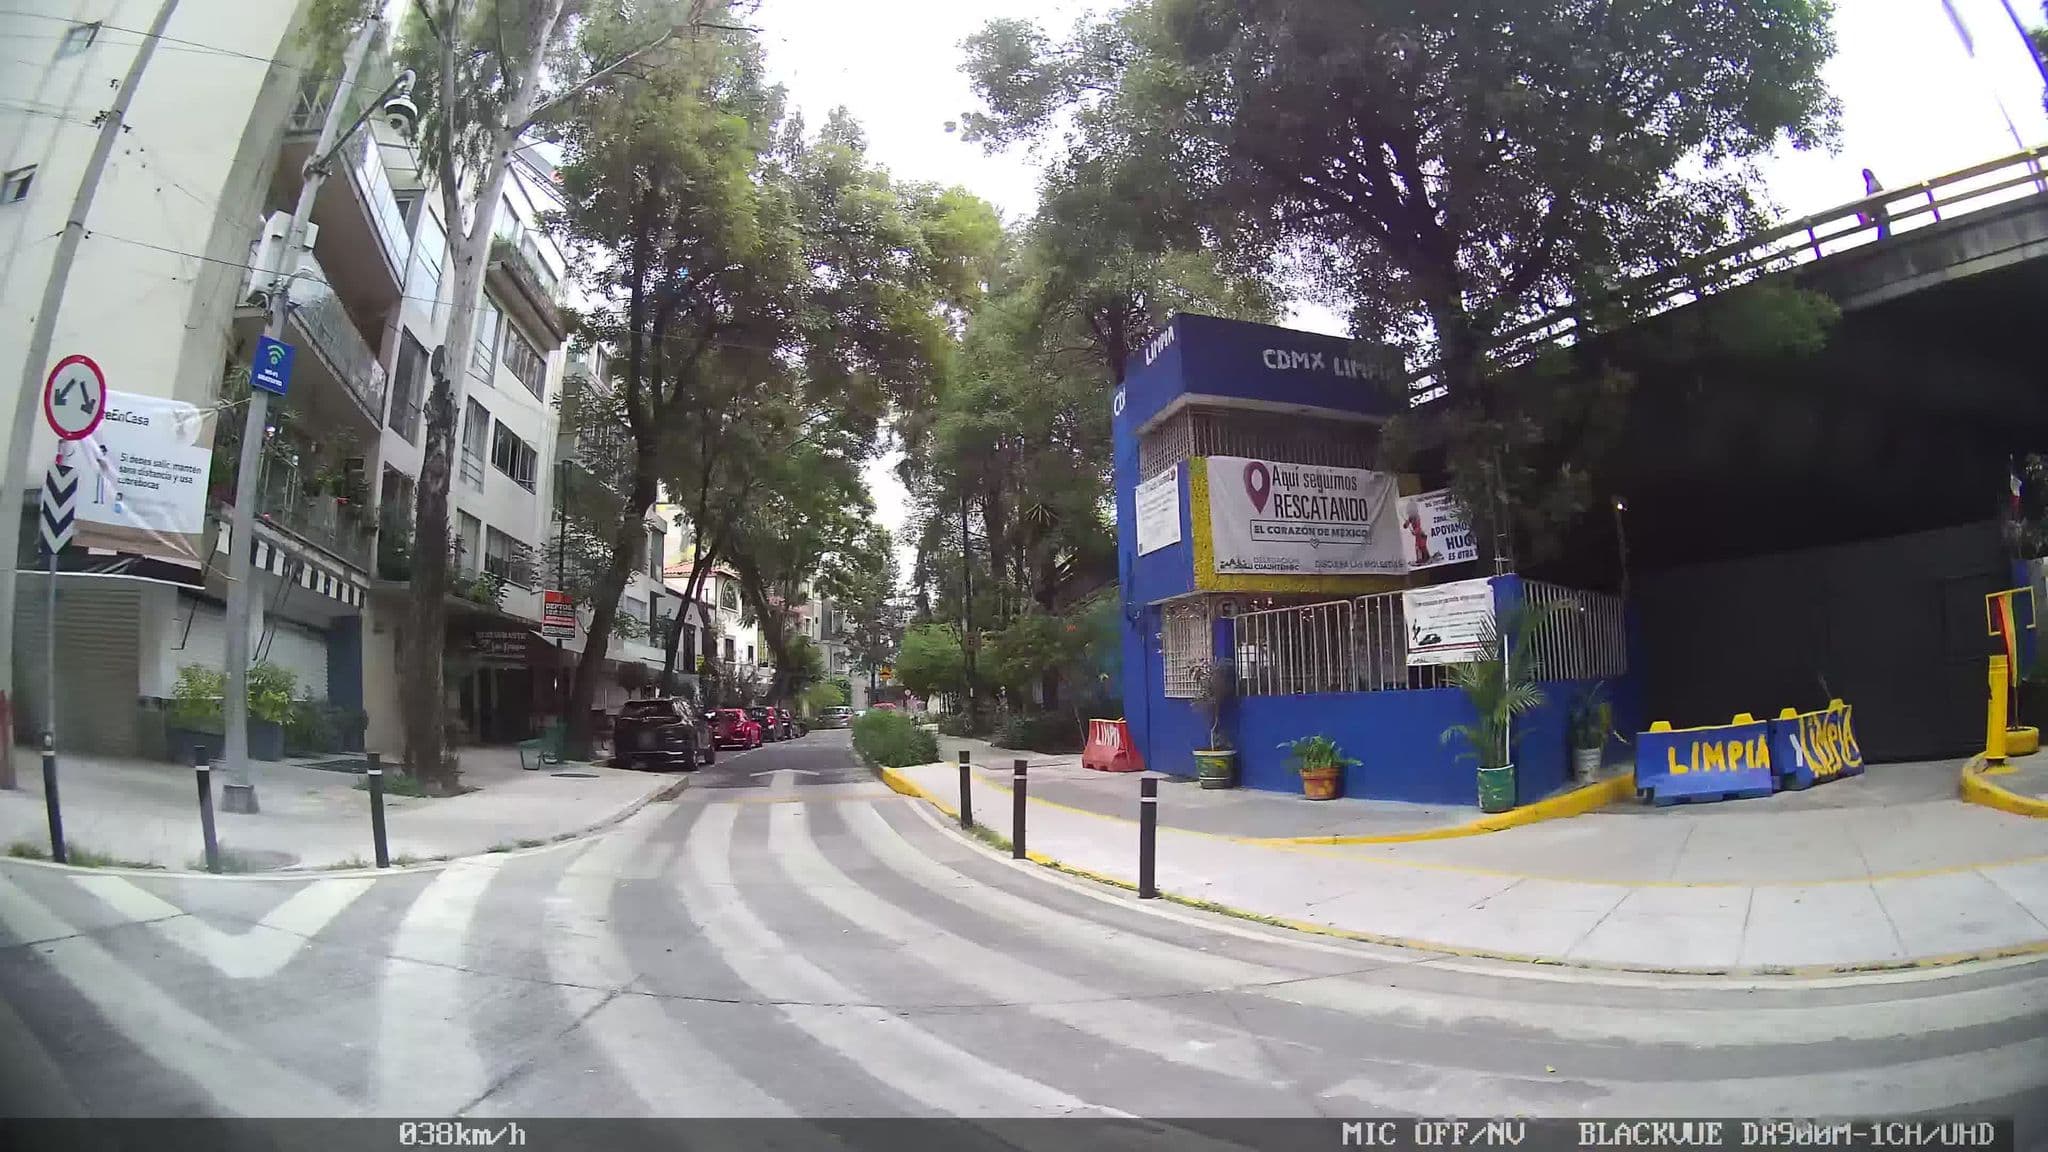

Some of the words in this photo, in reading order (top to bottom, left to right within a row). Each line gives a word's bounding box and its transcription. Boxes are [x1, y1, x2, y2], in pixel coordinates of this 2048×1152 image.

[1262, 348, 1325, 371] CDMX
[1272, 465, 1300, 491] Aquí
[1303, 468, 1358, 493] seguimos
[1273, 493, 1368, 521] RESCATANDO
[1254, 525, 1265, 534] EL
[1318, 527, 1330, 537] DE
[1431, 521, 1470, 537] APOYAMO
[1668, 734, 1770, 775] LIMPIA
